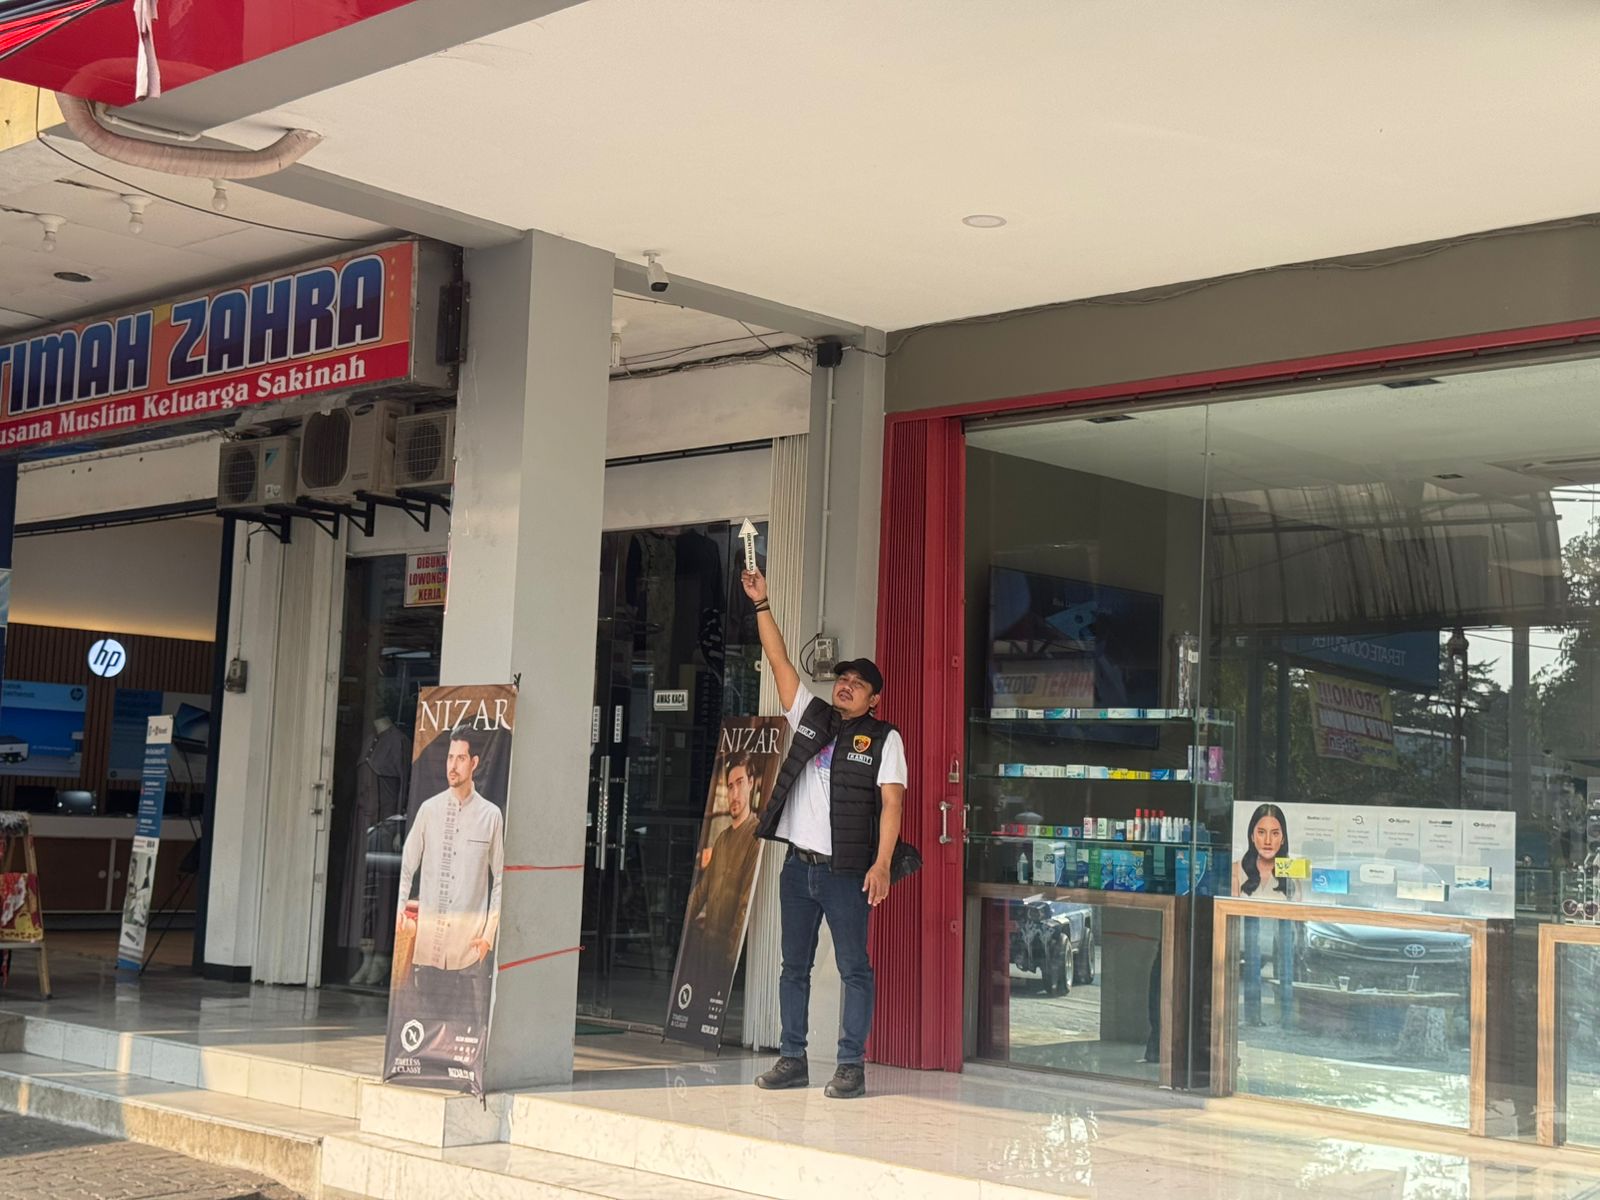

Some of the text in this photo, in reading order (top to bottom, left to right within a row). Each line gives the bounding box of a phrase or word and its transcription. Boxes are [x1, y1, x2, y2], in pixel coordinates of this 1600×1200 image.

[167, 254, 385, 384] ZAHRA
[58, 402, 136, 434] Muslim
[142, 382, 249, 419] Keluarga
[256, 354, 366, 398] Sakinah
[93, 639, 122, 677] hp
[418, 699, 512, 731] NIZAR
[720, 727, 780, 754] NIZAR
